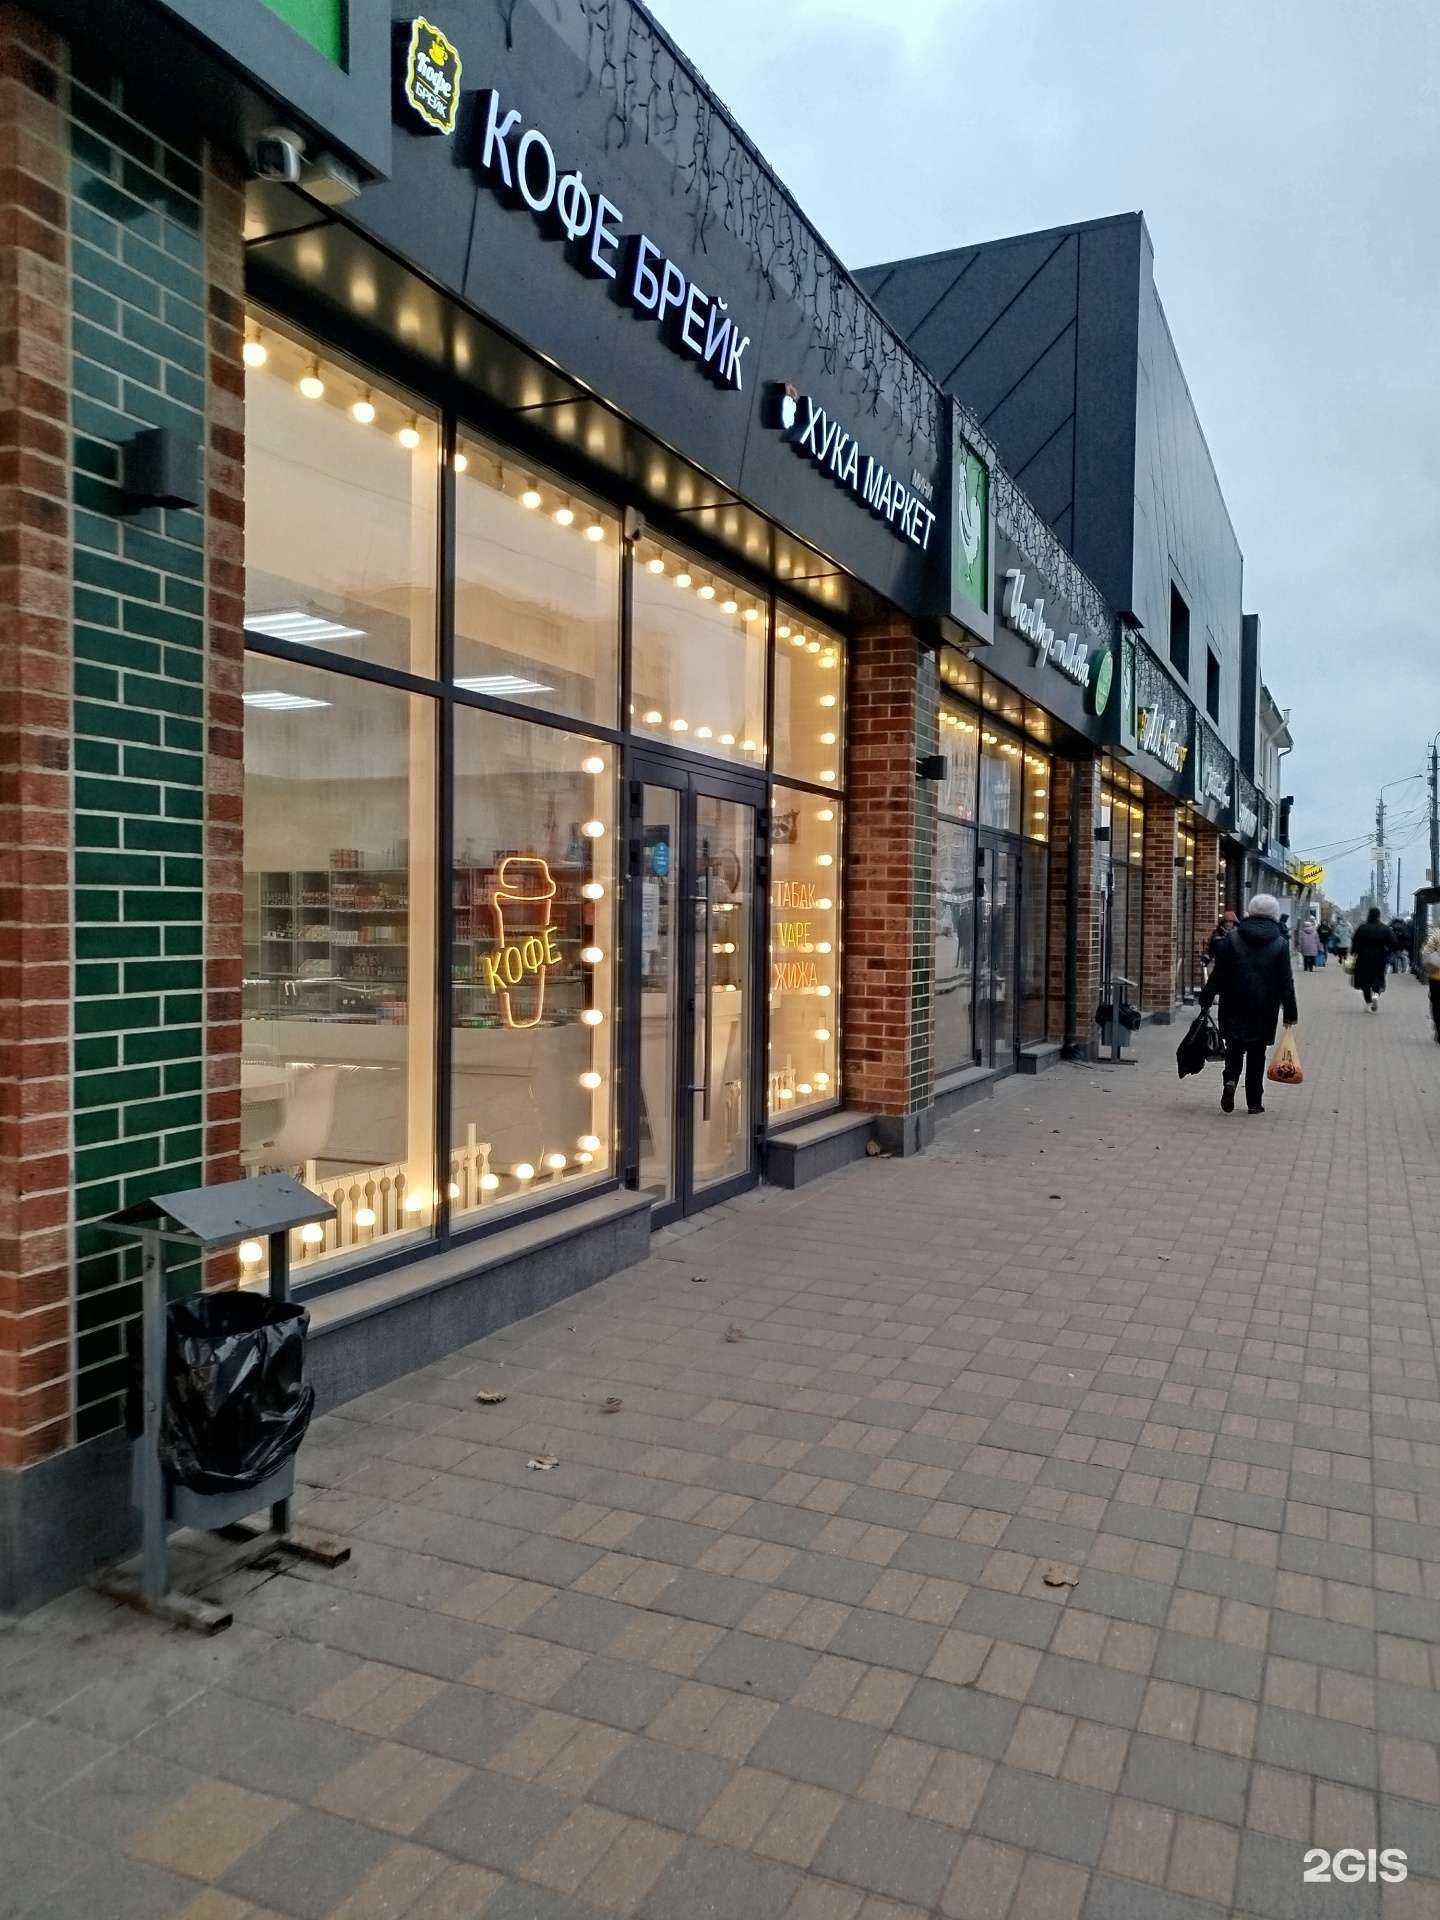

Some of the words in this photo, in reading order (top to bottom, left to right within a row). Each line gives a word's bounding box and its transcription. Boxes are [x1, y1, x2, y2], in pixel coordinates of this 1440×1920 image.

[482, 88, 624, 279] КОФЕ
[633, 235, 751, 391] БРЕЙК
[800, 396, 859, 491] ХУКА
[863, 456, 936, 550] МАРКЕТ
[773, 880, 816, 909] ТАБАК
[777, 922, 811, 948] VAPE
[484, 927, 562, 994] КОФЕ
[774, 961, 818, 993] ЖИЖА
